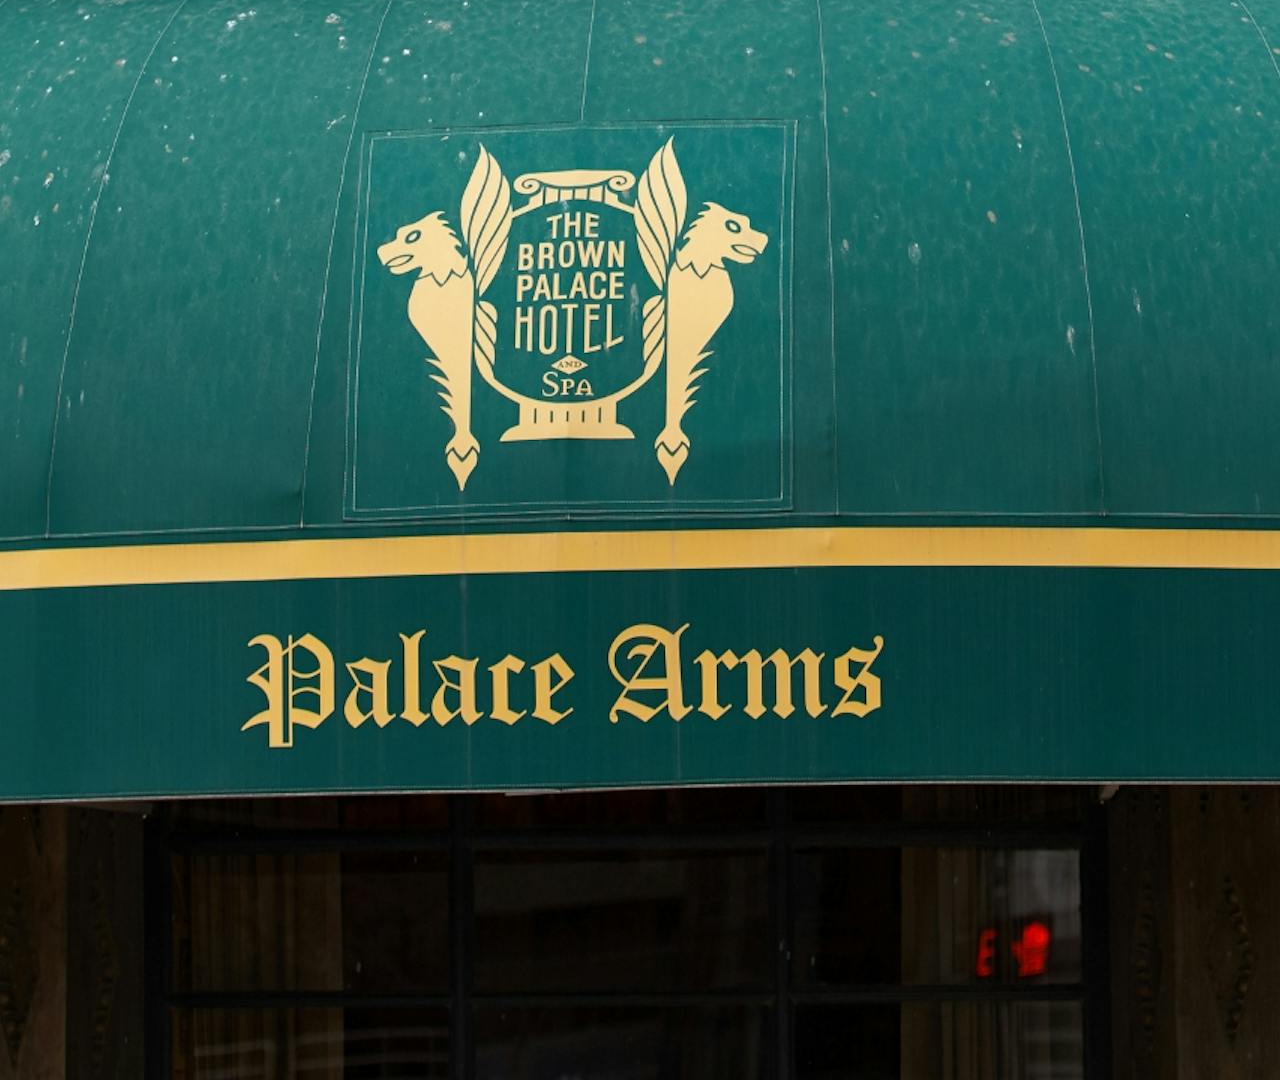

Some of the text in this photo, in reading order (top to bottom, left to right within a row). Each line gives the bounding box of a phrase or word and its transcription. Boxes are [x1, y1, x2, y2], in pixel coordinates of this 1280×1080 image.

[546, 211, 600, 239] THE
[517, 240, 625, 271] BROWN
[516, 271, 625, 302] PALACE
[514, 303, 624, 355] HOTEL
[240, 622, 885, 748] Palace Arms
